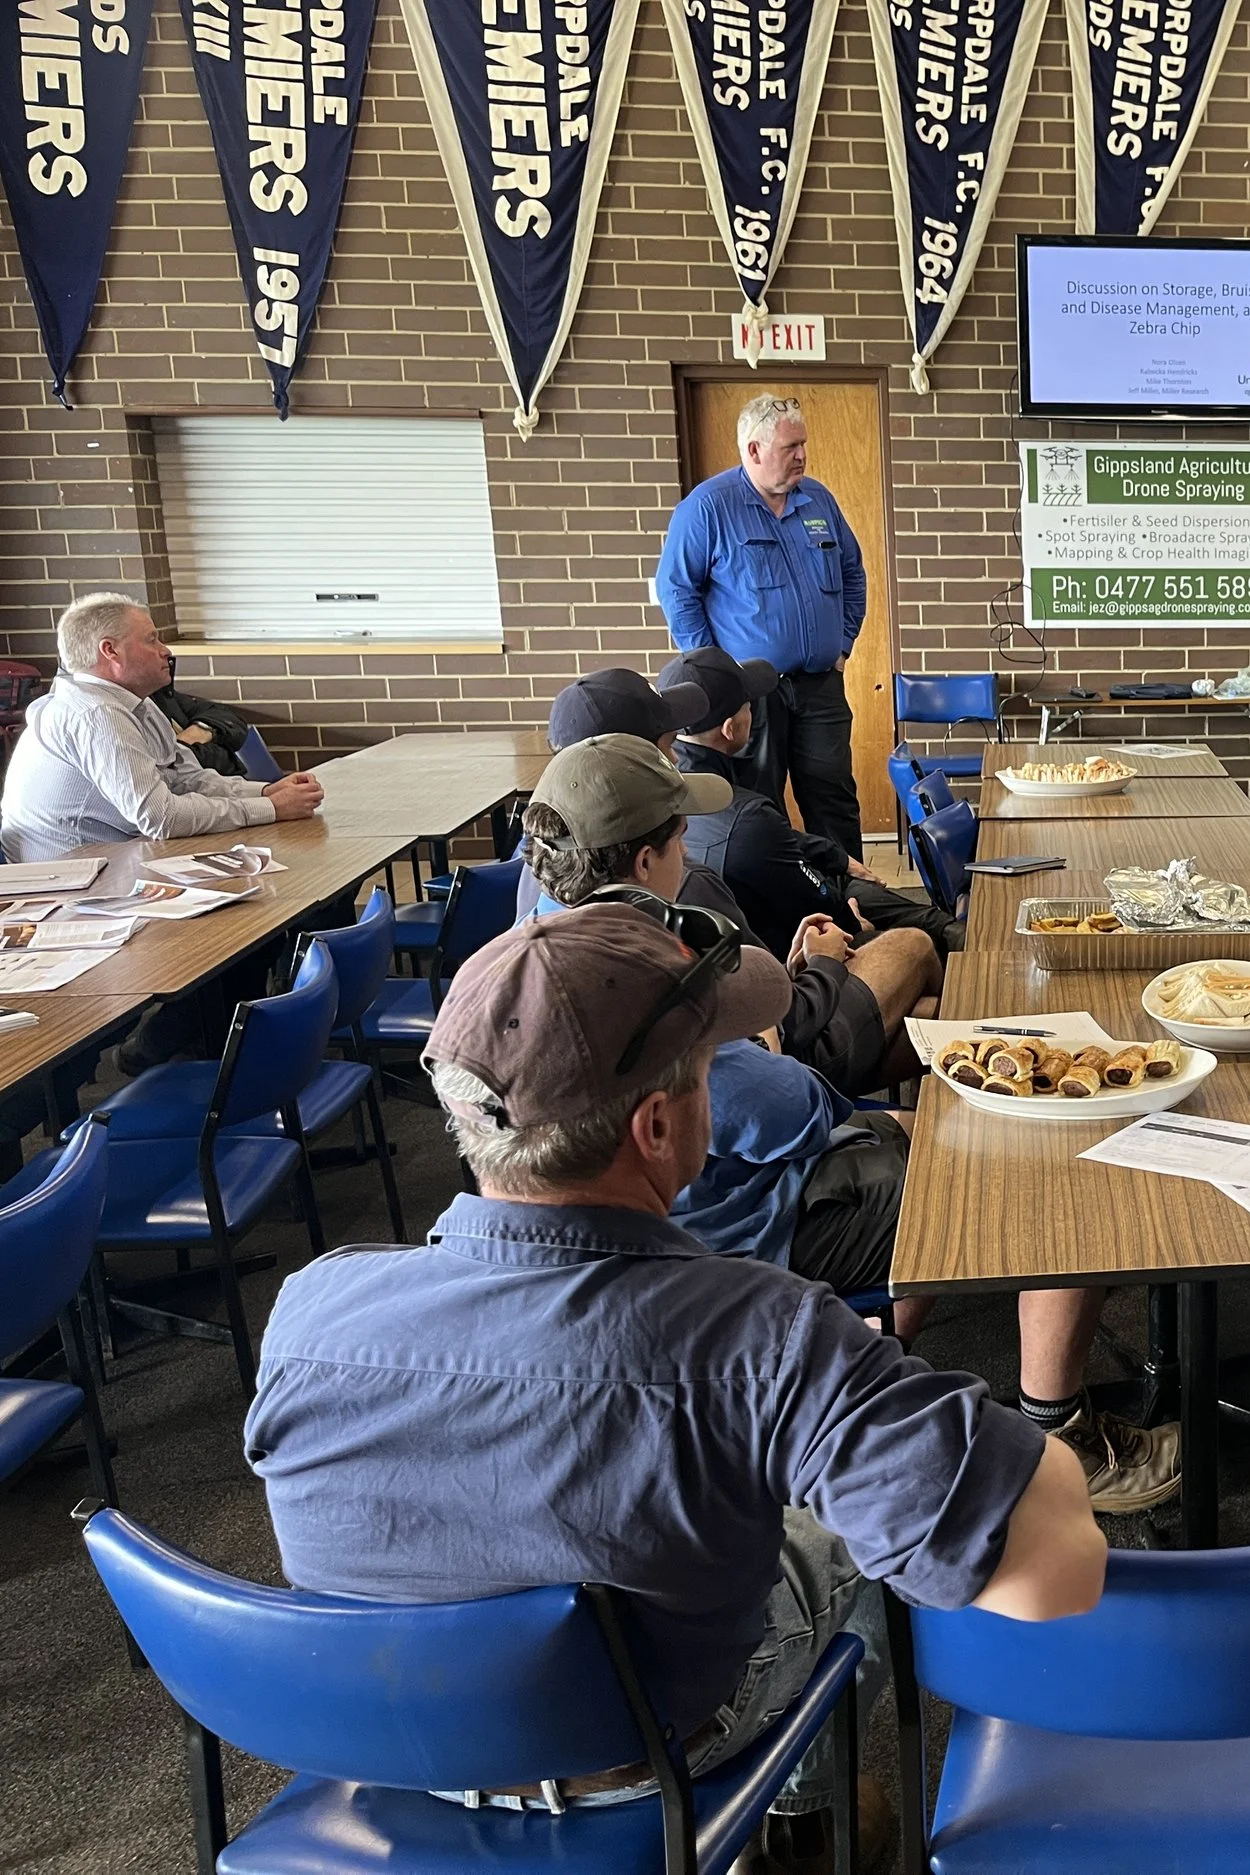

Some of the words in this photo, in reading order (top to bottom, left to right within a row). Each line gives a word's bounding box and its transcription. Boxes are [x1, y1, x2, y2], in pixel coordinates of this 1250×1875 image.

[554, 0, 592, 148] PDALE
[915, 0, 960, 152] MIERS
[243, 0, 308, 217] MIERS
[759, 127, 788, 195] F.C.
[955, 152, 985, 214] F.C.
[733, 204, 771, 281] 1961
[916, 216, 959, 305] 1964
[1066, 281, 1137, 295] Discussion
[1141, 285, 1159, 296] on
[1163, 282, 1217, 299] Storage,
[252, 245, 301, 368] 1957
[1061, 301, 1086, 314] and
[1090, 302, 1142, 315] Disease
[1146, 302, 1239, 318] Management,
[772, 323, 816, 351] EXIT
[1129, 321, 1167, 335] Zebra
[1171, 322, 1201, 337] Chip
[1093, 455, 1176, 478] Gippsland
[1122, 479, 1170, 497] Drone
[1175, 480, 1245, 501] Spraying
[1132, 515, 1142, 527] &
[1146, 515, 1178, 528] Seed
[1183, 515, 1250, 530] Dispersion
[1046, 530, 1076, 545] Spot
[1080, 530, 1136, 545] Spraying
[1149, 531, 1216, 543] Broadacre
[1055, 546, 1114, 561] Mapping
[1117, 547, 1127, 559] &
[1132, 547, 1164, 561] Crop
[1167, 547, 1210, 560] Health
[1052, 576, 1087, 599] Ph:
[1095, 576, 1156, 599] 0477
[1163, 576, 1209, 599] 551
[1053, 601, 1086, 614] Email:
